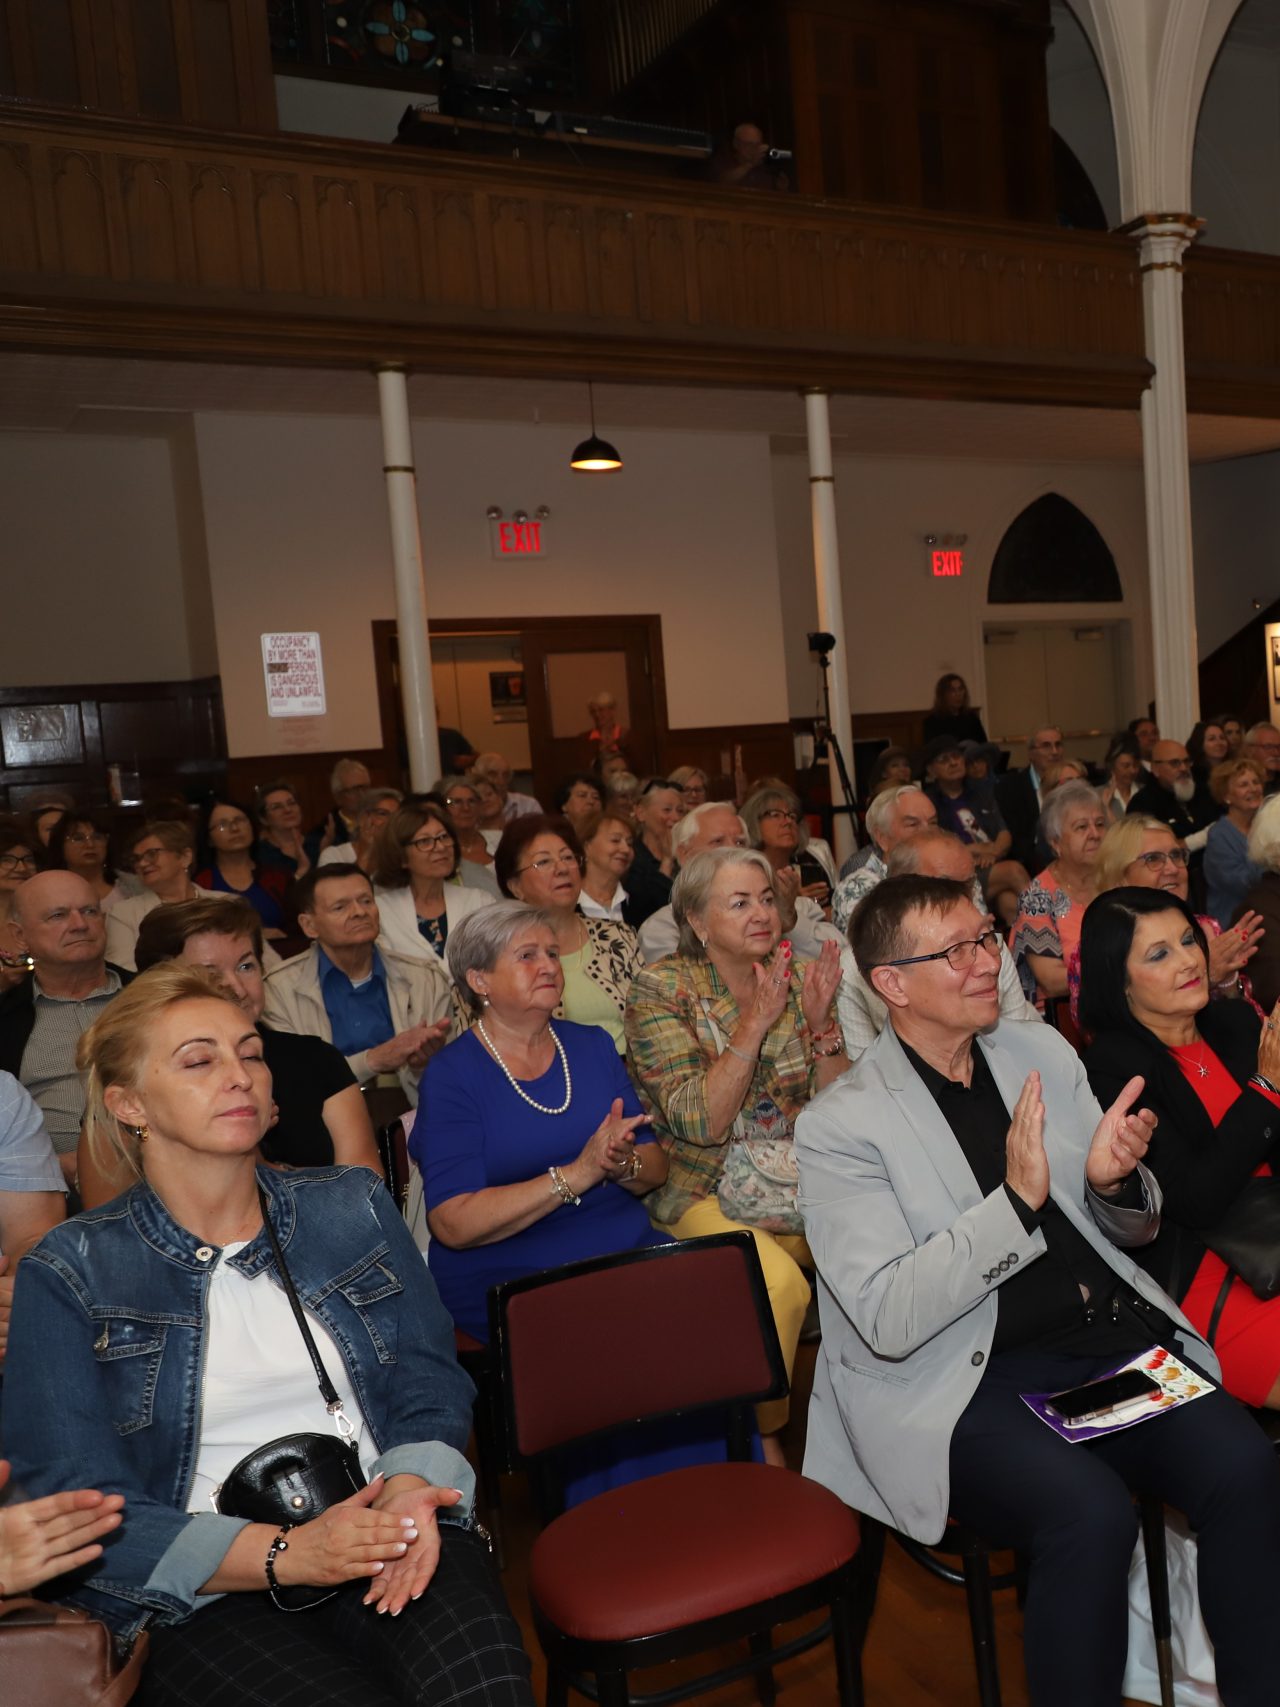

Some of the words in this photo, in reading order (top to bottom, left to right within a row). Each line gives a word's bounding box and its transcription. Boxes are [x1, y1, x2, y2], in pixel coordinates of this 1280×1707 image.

[499, 522, 541, 553] EXIT
[932, 551, 962, 576] EXIT
[271, 636, 309, 648] OCCUPANCY
[268, 649, 277, 662] BY
[278, 649, 297, 661] MORE
[298, 649, 316, 660] THAN
[288, 661, 317, 672] PERSONS
[278, 673, 318, 686] DANGEROUS
[271, 687, 284, 698] AND
[286, 686, 322, 698] UNLAWFUL
